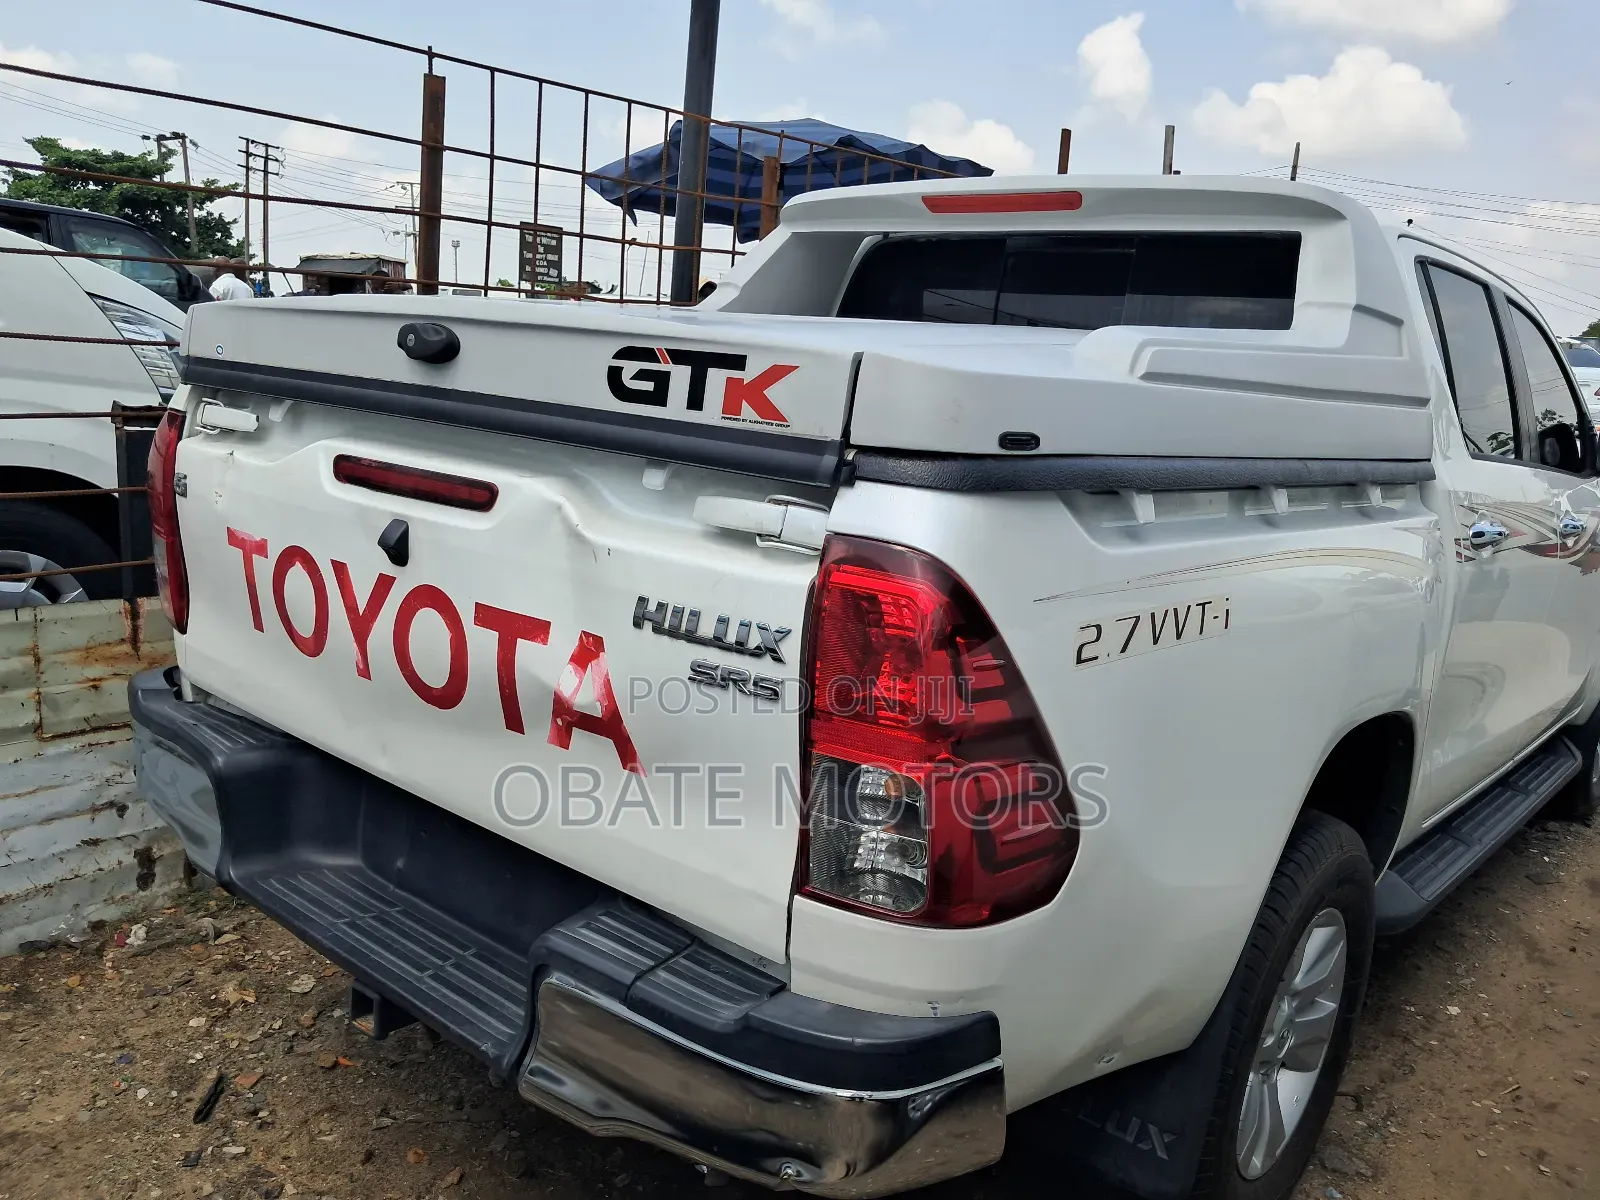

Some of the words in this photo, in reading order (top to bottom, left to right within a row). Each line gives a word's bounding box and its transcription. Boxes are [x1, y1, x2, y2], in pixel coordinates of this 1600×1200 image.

[606, 345, 801, 423] GTK
[226, 525, 649, 779] TOYOTA
[632, 594, 793, 665] HILUX
[687, 658, 785, 704] SR5
